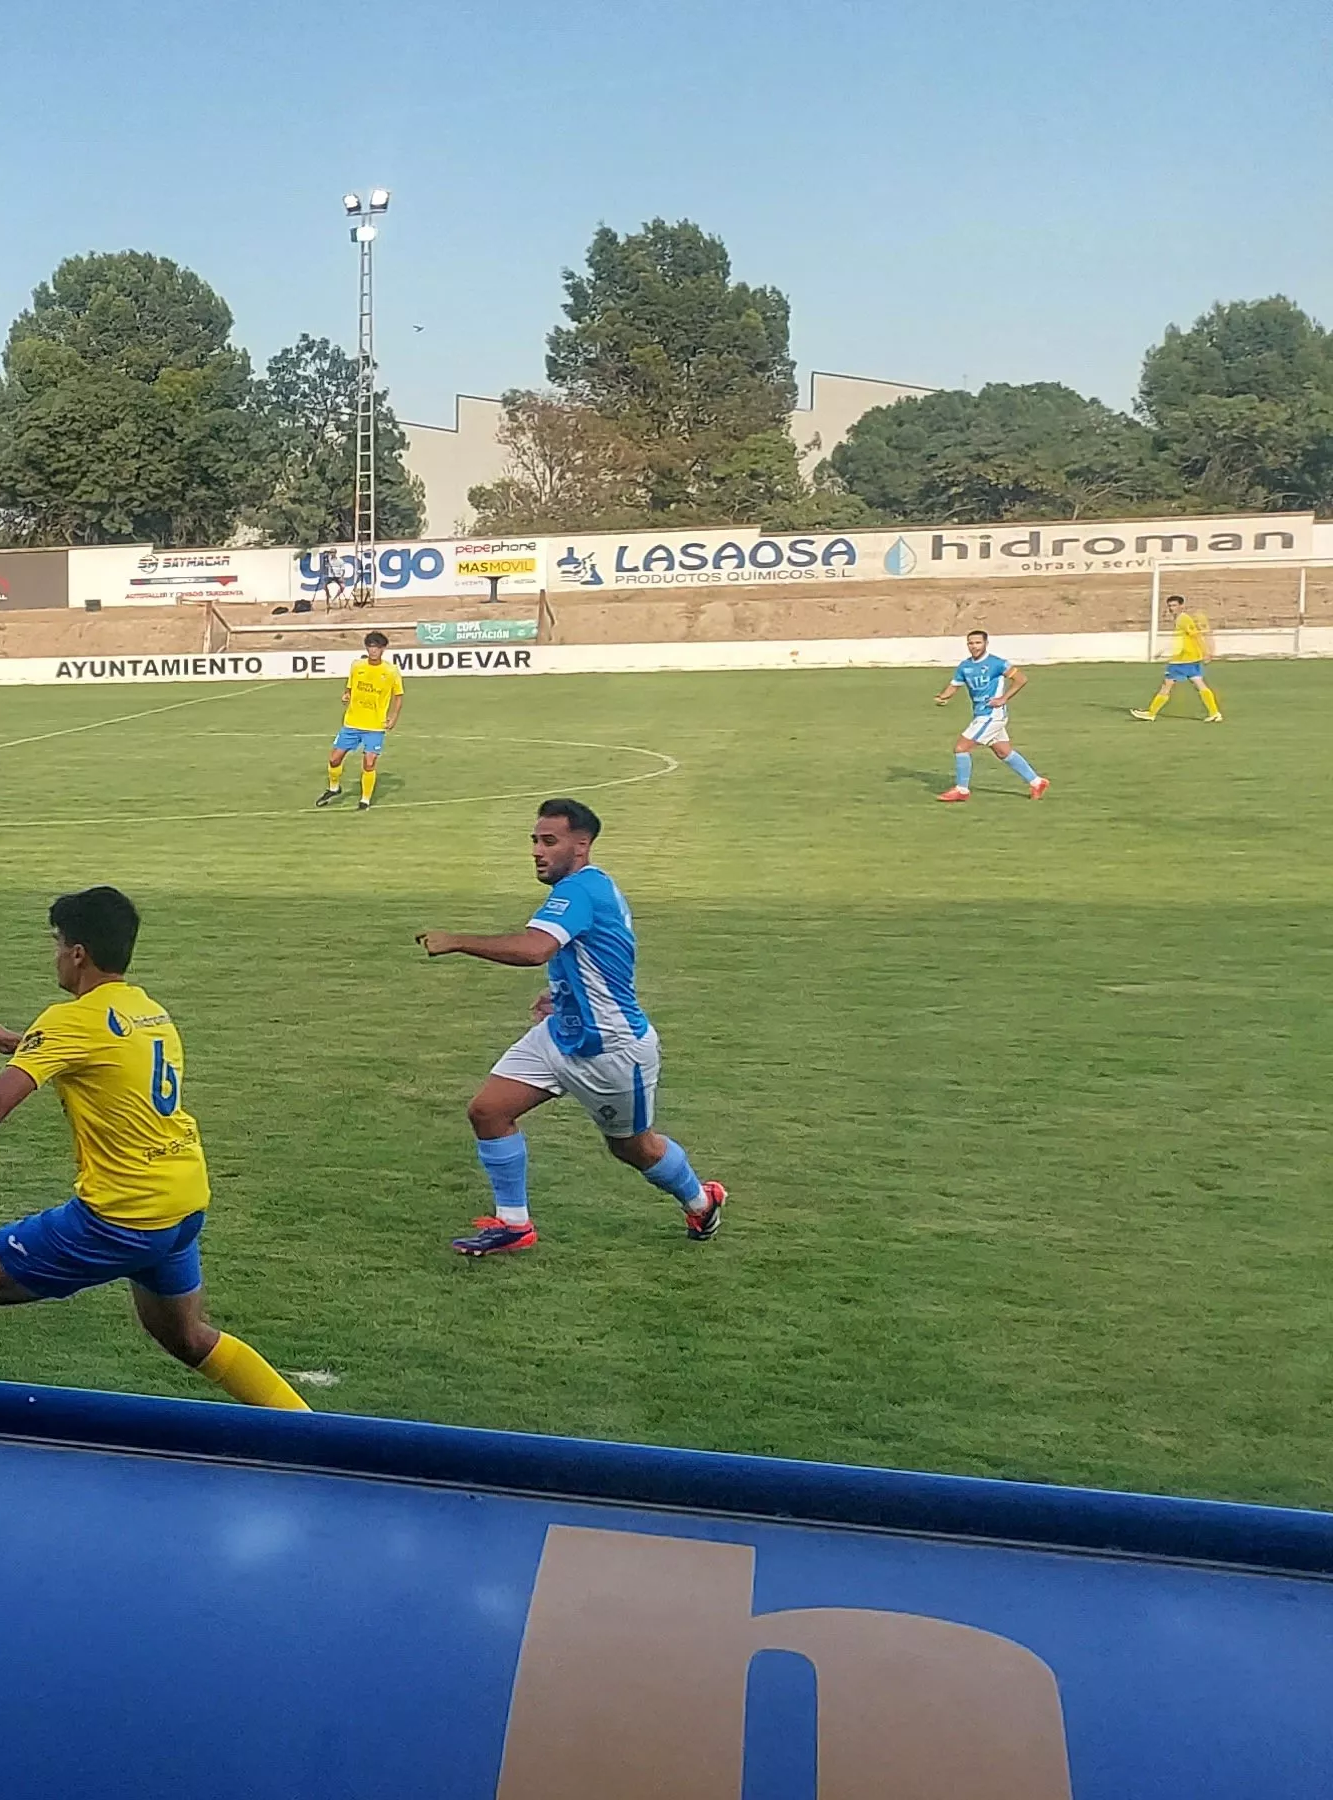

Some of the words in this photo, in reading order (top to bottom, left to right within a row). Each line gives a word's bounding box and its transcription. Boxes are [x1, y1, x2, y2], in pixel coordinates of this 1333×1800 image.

[455, 541, 537, 556] pepephone
[930, 530, 1294, 561] hidroman
[615, 538, 857, 573] LASAOSA
[458, 561, 533, 573] MASMOVIL
[1021, 561, 1076, 571] obras
[1084, 561, 1094, 572] y
[614, 571, 722, 584] PRODUCTOS
[456, 621, 481, 632] COPA
[455, 627, 511, 641] DIPUTACIÓN
[55, 656, 263, 679] AYUNTAMIENTO
[292, 656, 326, 674] DE
[391, 650, 532, 672] MUDEVAR
[153, 1039, 180, 1117] 6
